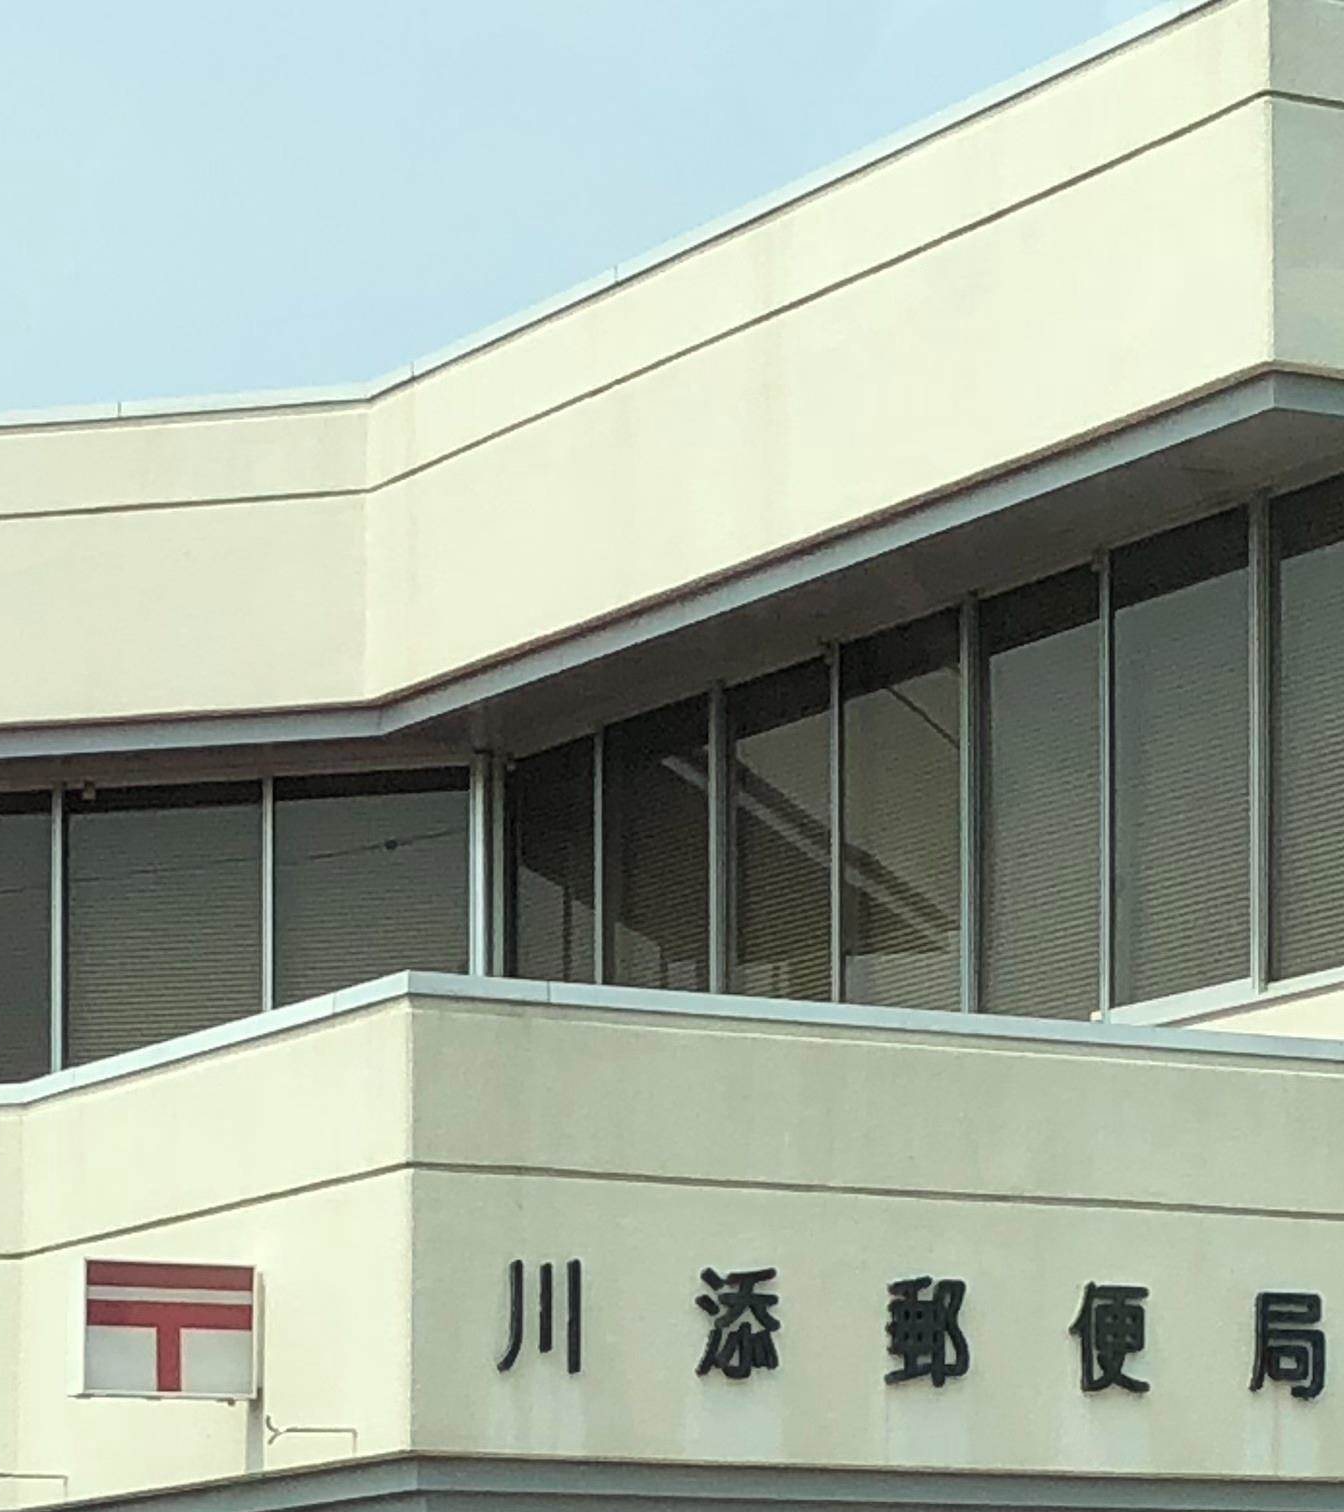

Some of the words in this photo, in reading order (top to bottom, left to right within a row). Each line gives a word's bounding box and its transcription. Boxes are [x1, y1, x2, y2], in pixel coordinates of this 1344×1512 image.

[497, 1258, 1326, 1401] 川添郵便局
